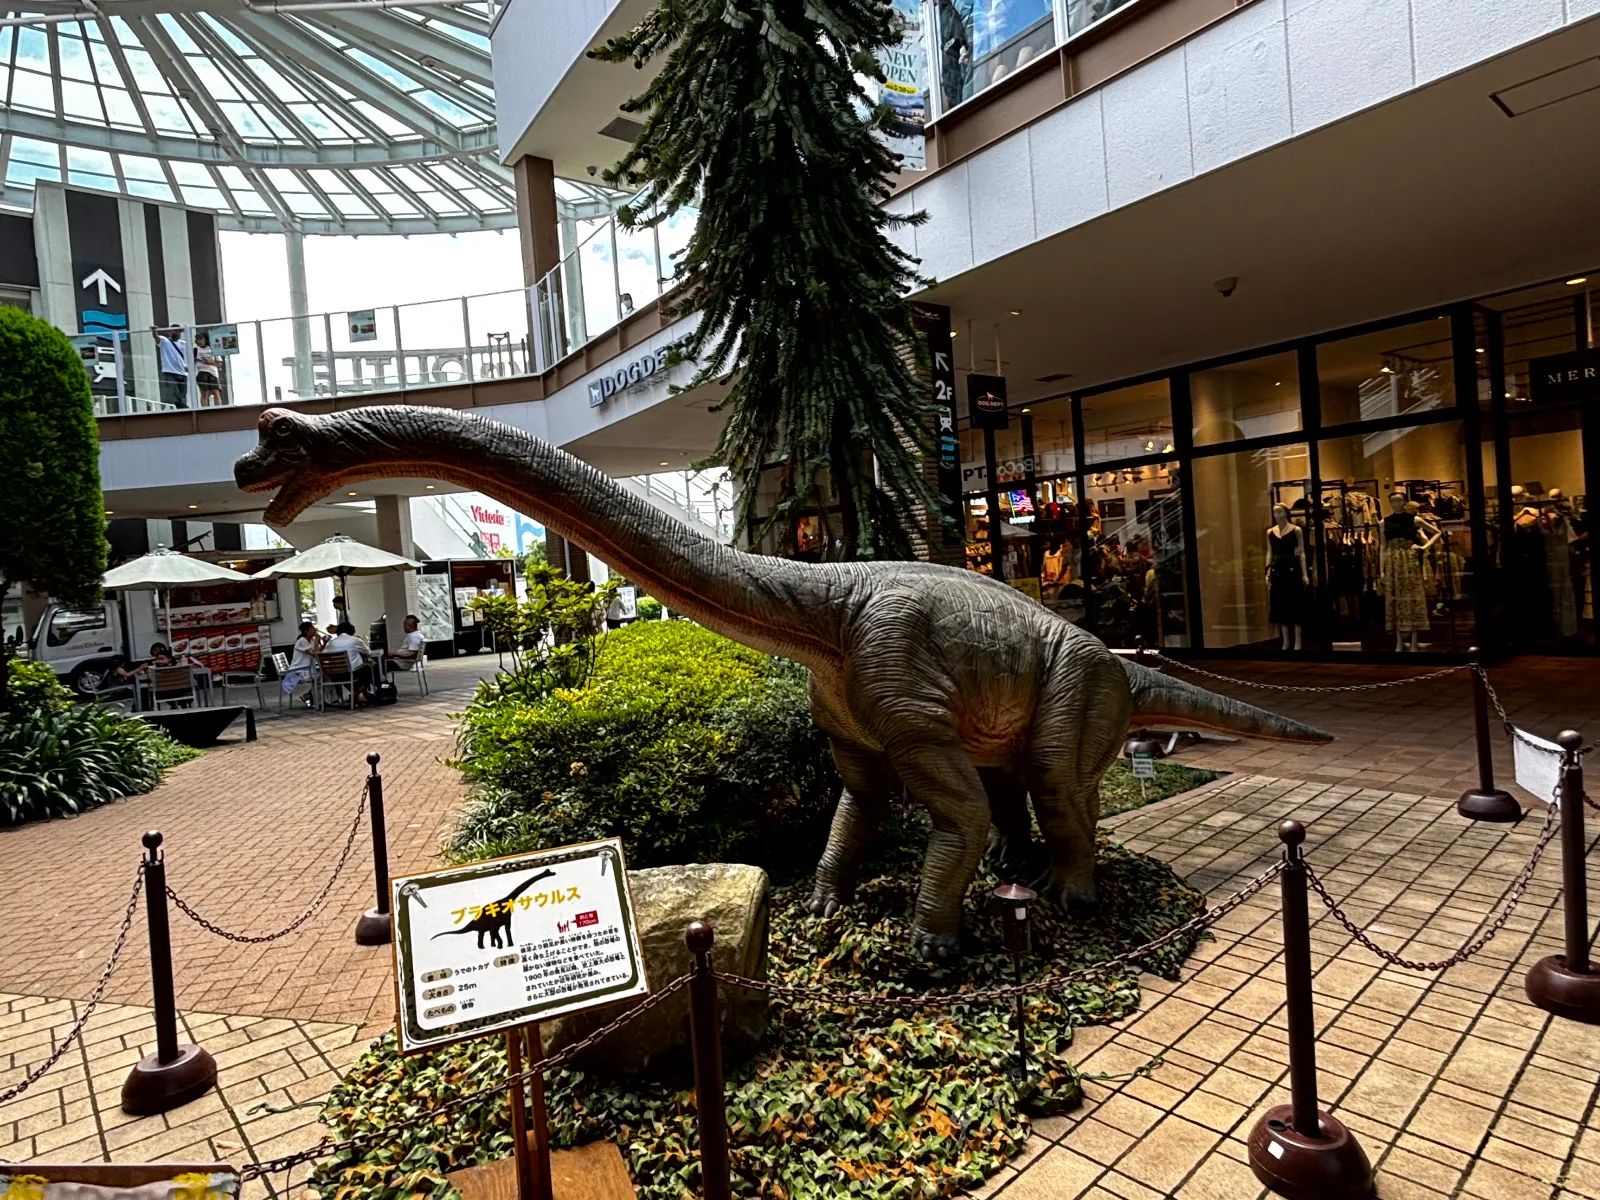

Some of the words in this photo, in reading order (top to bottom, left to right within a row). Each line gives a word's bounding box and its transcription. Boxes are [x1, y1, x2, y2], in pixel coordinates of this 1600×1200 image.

[885, 50, 917, 68] NEW
[881, 63, 918, 83] OPEN
[1547, 367, 1596, 384] MER
[935, 379, 952, 401] 2F
[451, 886, 581, 924] ブラキオサウルス
[454, 961, 490, 976] うでのトカゲ
[458, 982, 477, 992] 25m
[427, 1004, 454, 1017] たべもの
